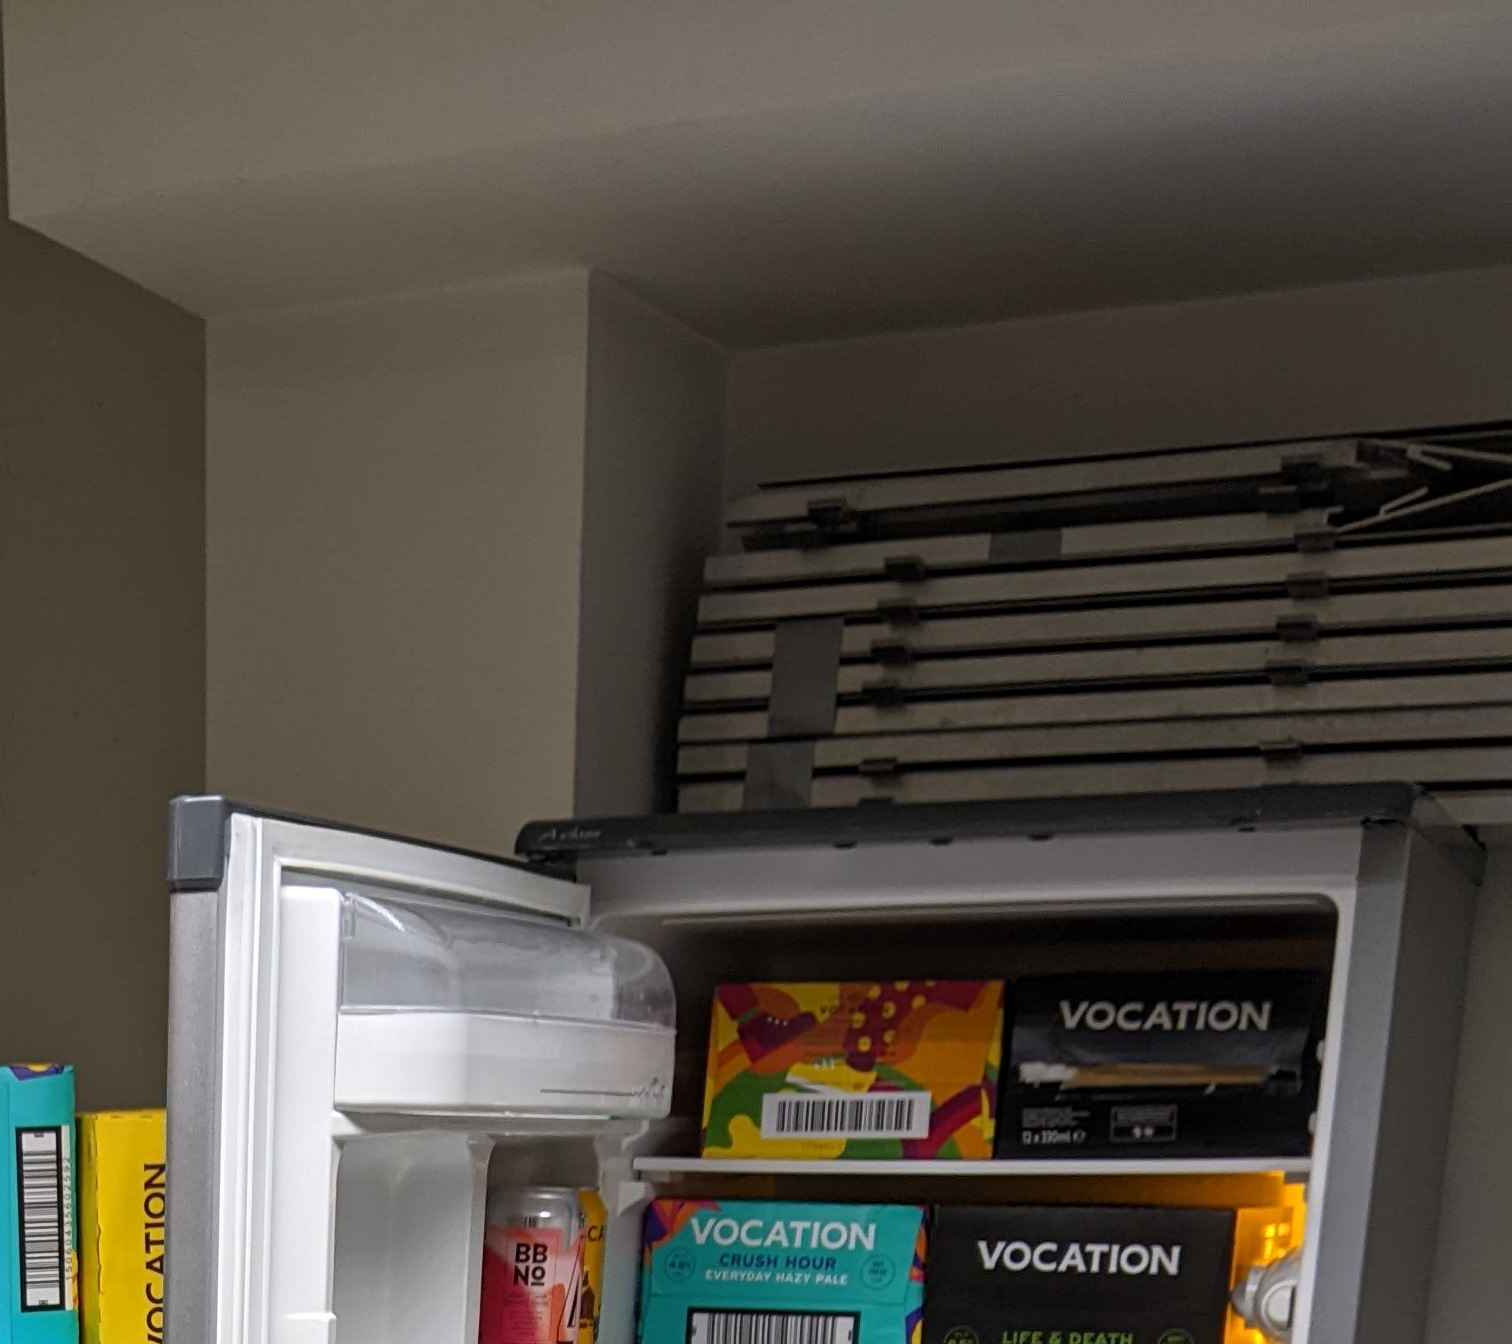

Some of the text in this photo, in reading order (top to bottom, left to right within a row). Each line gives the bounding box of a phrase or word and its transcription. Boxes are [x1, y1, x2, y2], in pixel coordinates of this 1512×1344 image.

[1059, 1000, 1273, 1032] VOCATION
[690, 1216, 877, 1251] VOCATION
[515, 1242, 549, 1264] BB
[719, 1252, 838, 1270] CRUSH HOUR
[977, 1240, 1183, 1277] VOCATION
[705, 1269, 848, 1286] EVERYDAY HAZY PALE
